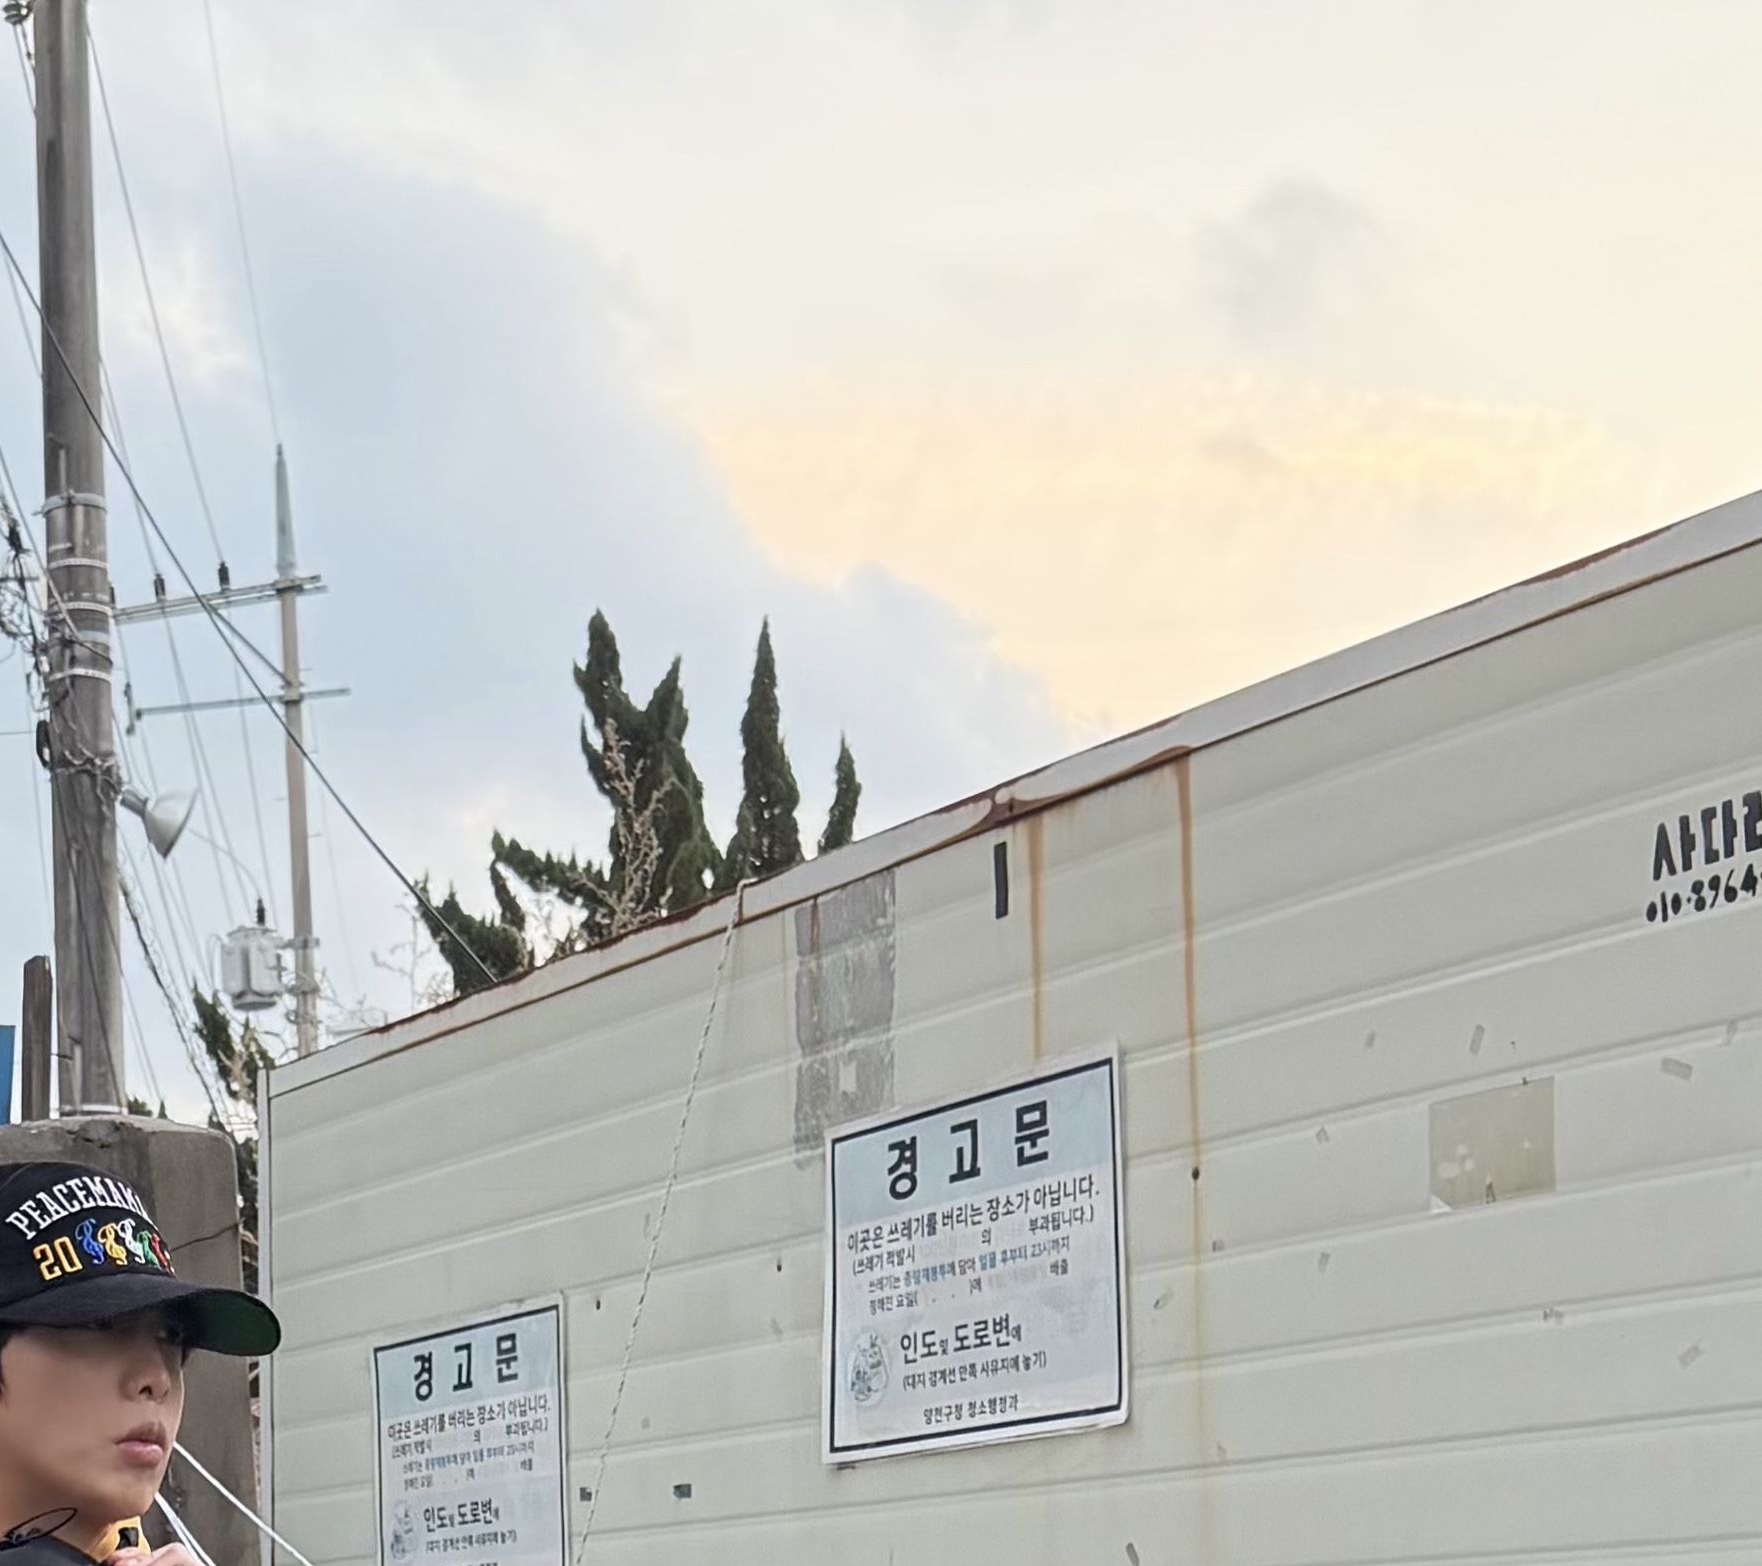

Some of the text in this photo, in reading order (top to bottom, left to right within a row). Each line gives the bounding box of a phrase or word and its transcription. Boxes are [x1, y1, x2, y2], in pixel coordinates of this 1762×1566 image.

[5, 1175, 158, 1241] PEACEMAK
[848, 1174, 1100, 1253] 이곳은 쓰레기를 버리는 장소가 아닙니다.
[32, 1235, 83, 1282] 20
[953, 1312, 1022, 1353] 도로변에
[508, 1393, 551, 1418] 아닙니다.
